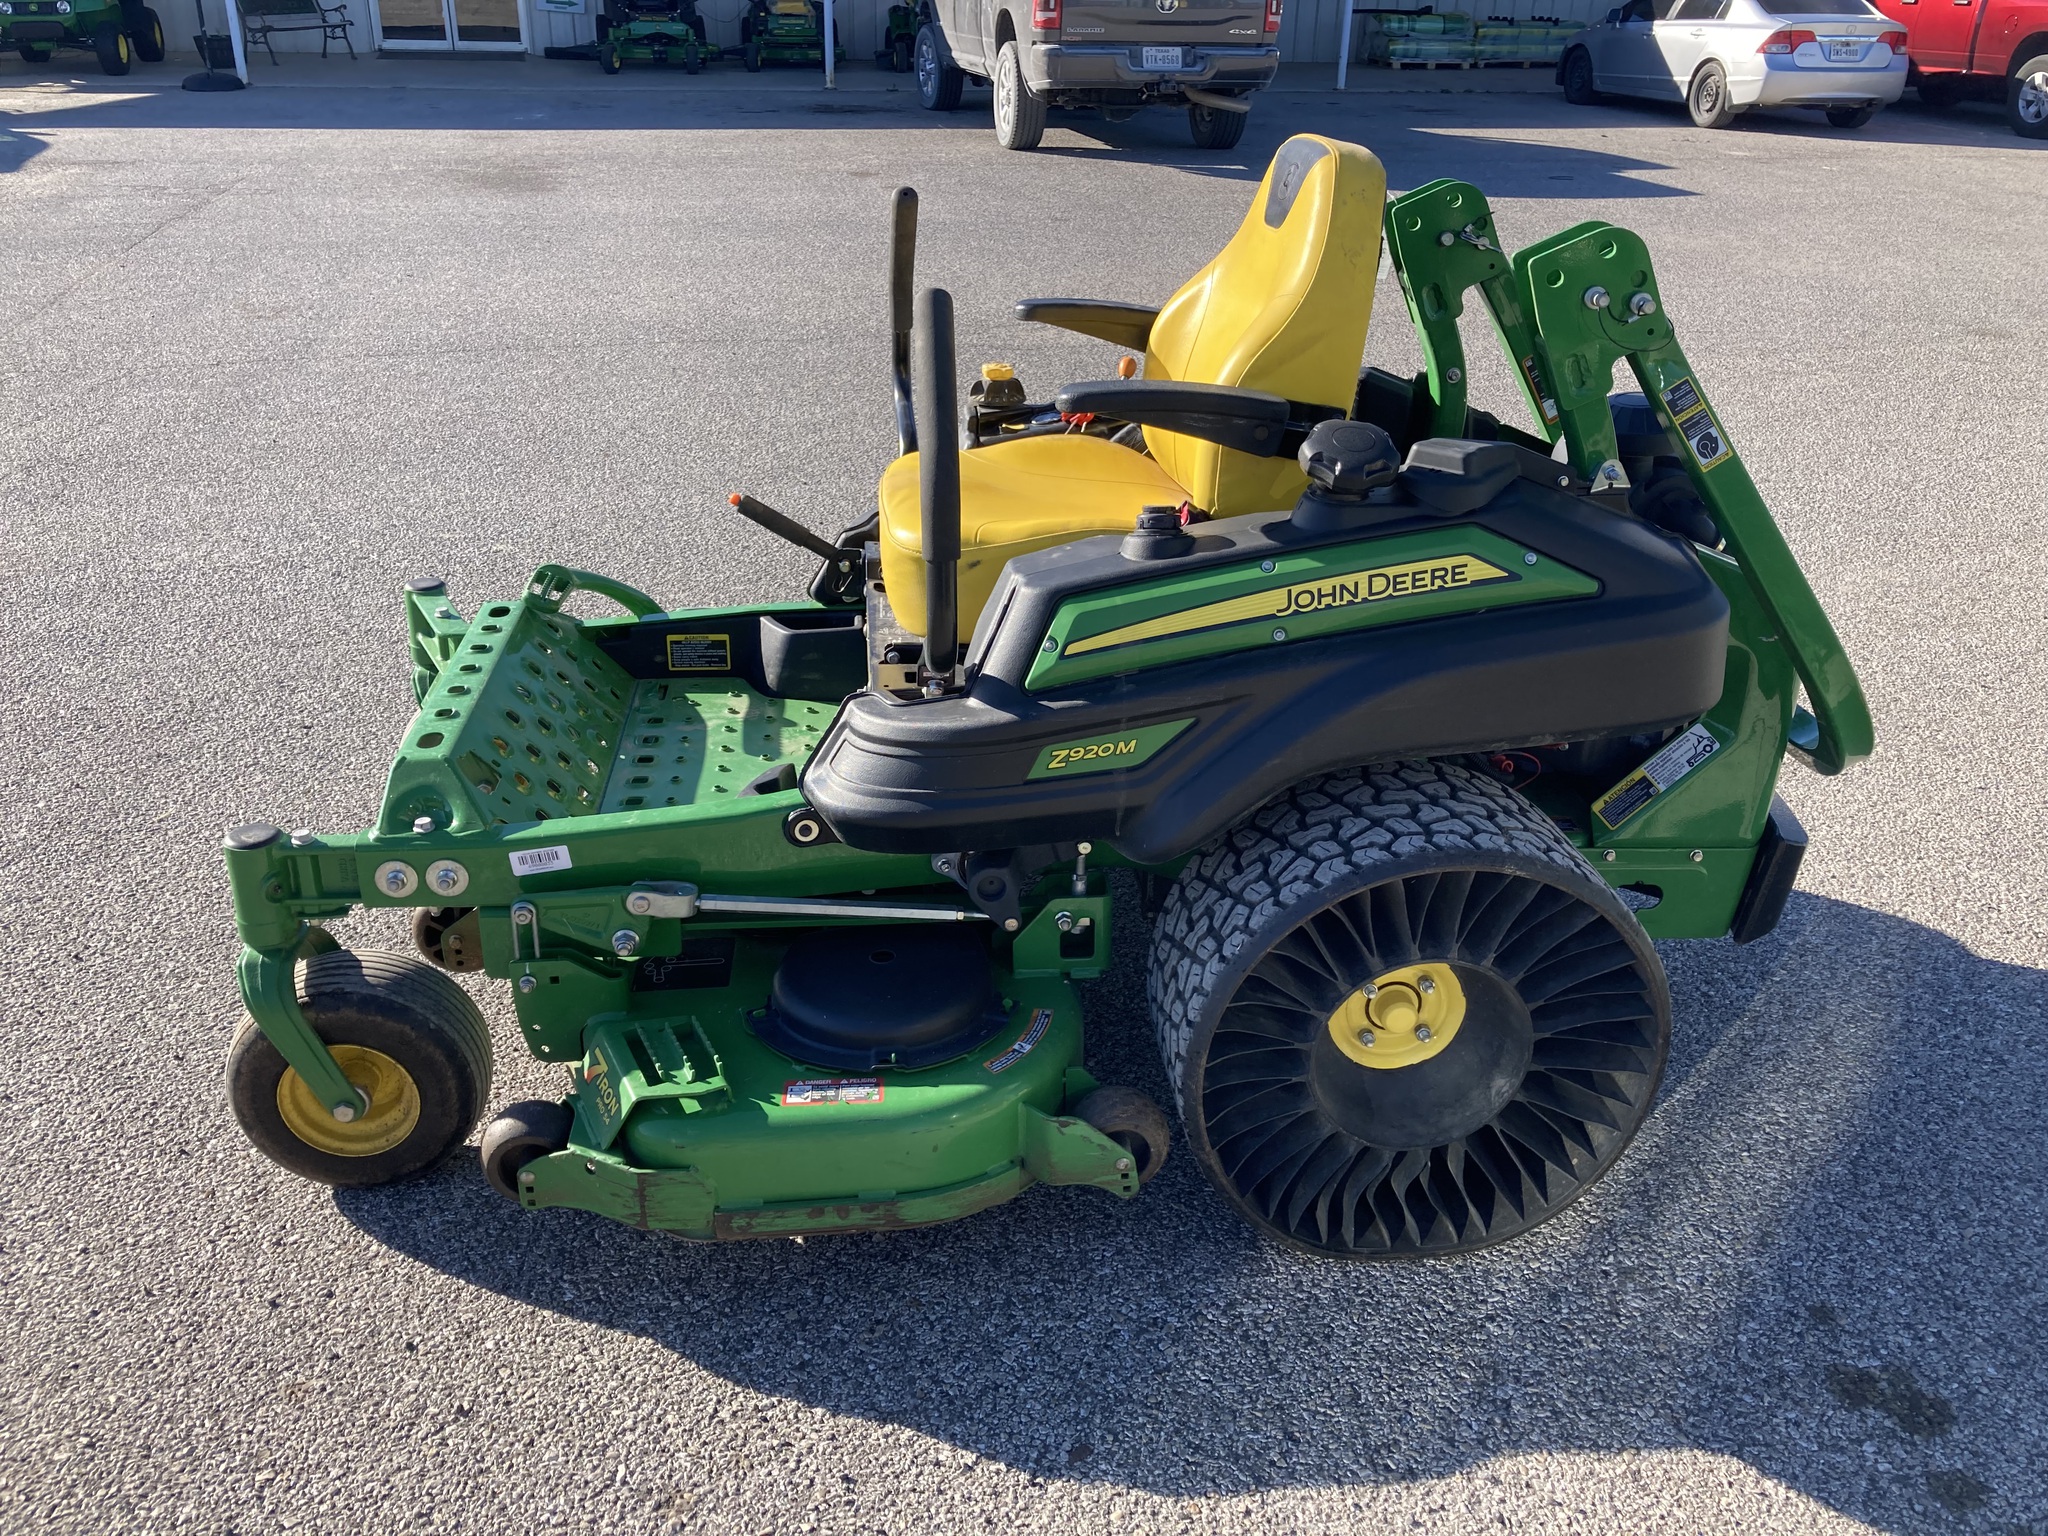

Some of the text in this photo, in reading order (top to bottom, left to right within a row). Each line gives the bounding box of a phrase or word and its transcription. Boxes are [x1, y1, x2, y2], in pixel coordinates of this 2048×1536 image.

[1703, 454, 1726, 470] CAUTION
[1275, 563, 1469, 614] JOHN DEERE
[1047, 739, 1137, 769] Z920M
[1607, 776, 1636, 801] ATENCIÓN
